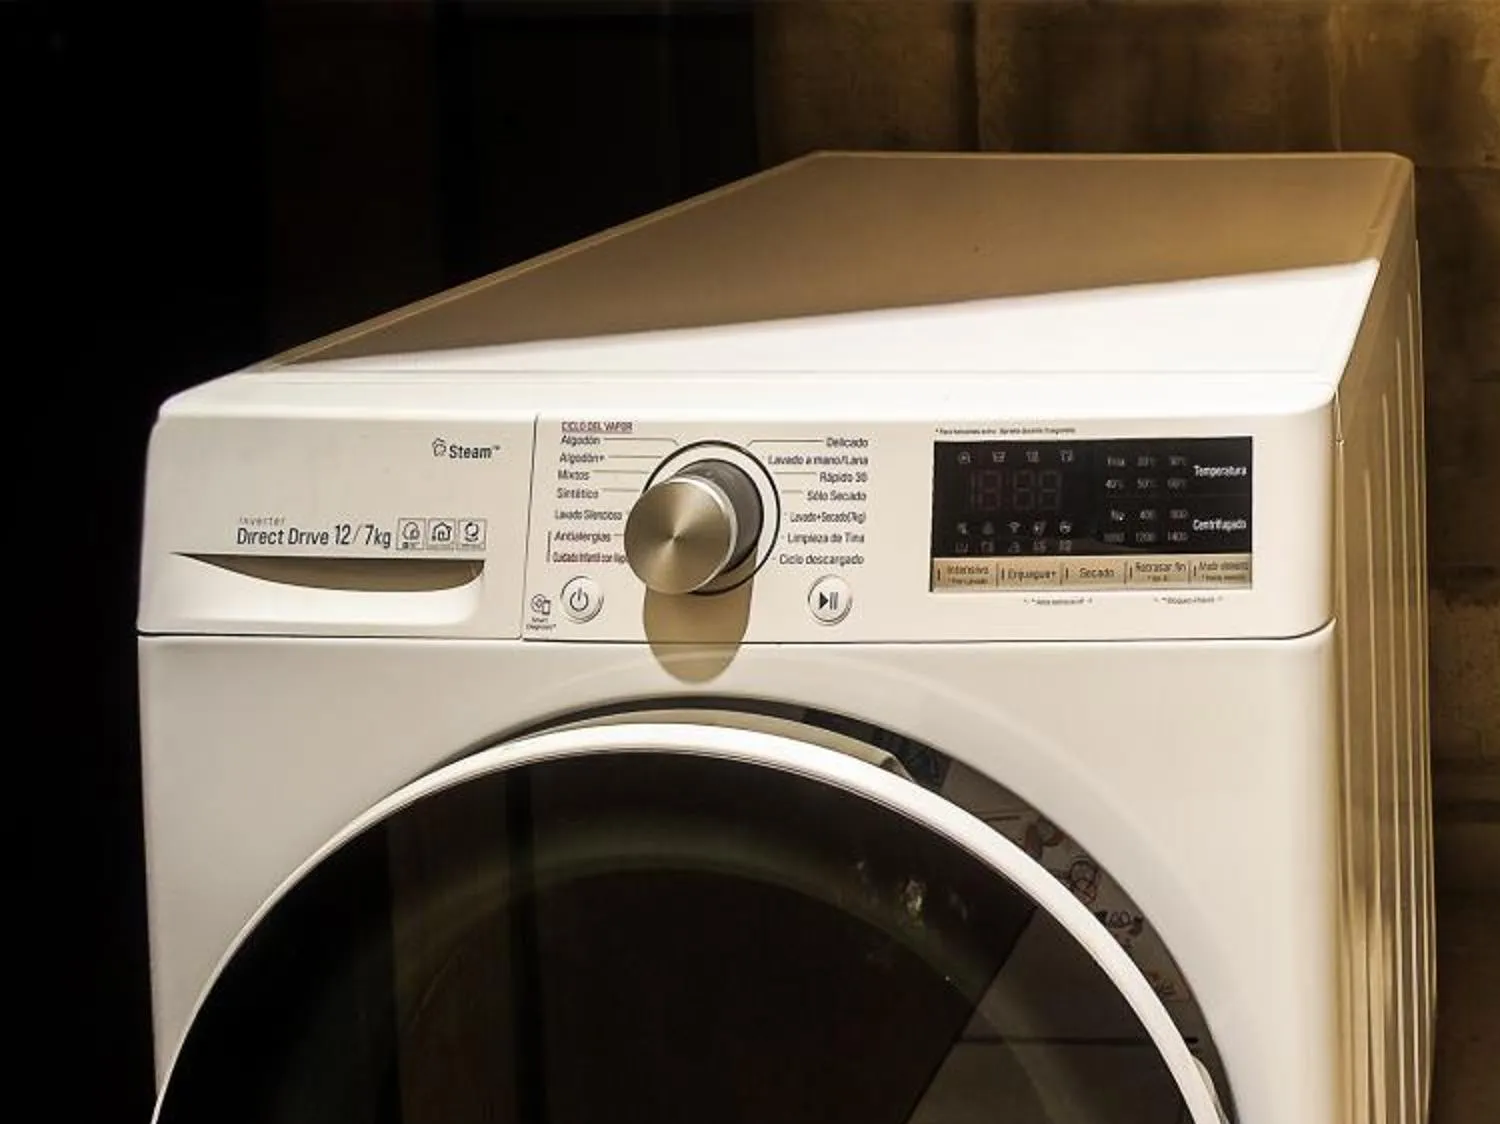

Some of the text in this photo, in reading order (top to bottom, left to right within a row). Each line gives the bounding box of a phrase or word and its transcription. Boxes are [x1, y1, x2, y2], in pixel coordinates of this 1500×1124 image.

[560, 435, 600, 447] Algodón
[826, 437, 868, 448] Delicado
[1193, 464, 1247, 477] Temperatura
[830, 490, 867, 501] Secado
[236, 526, 286, 546] Direct
[288, 527, 330, 545] Drive
